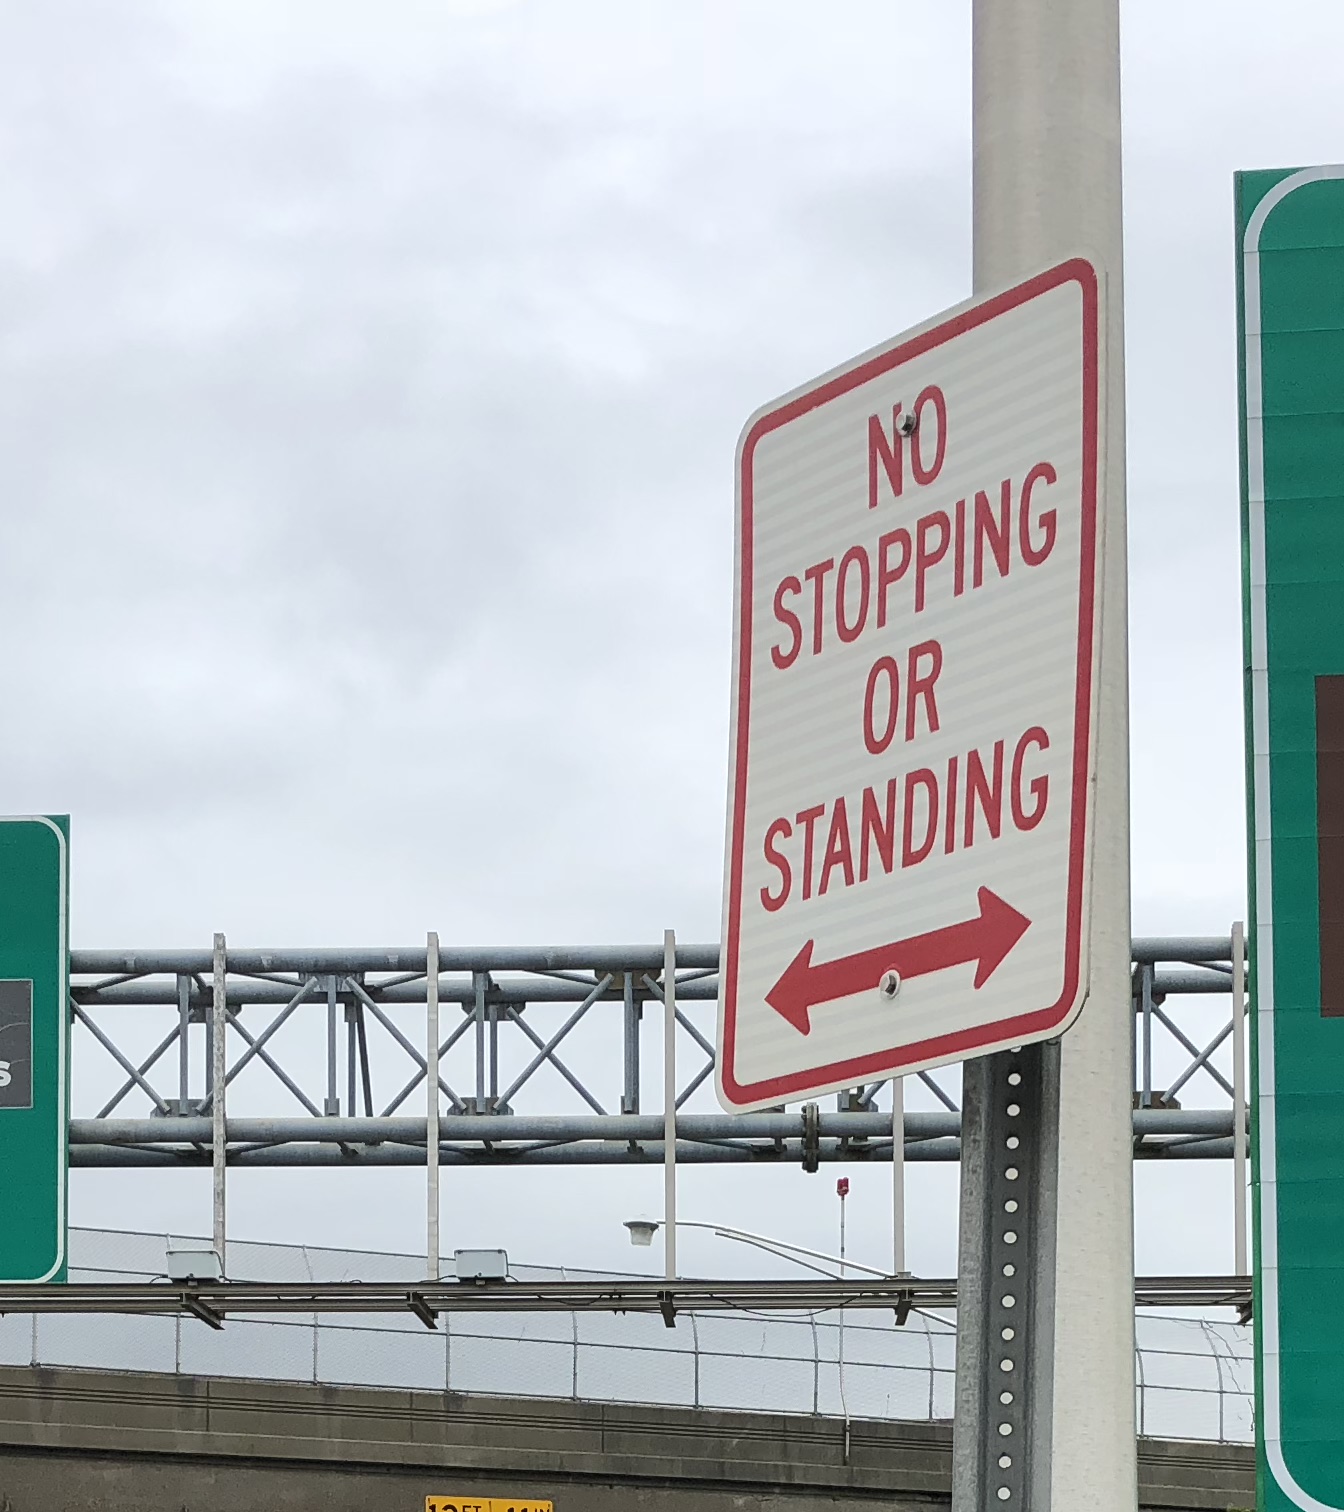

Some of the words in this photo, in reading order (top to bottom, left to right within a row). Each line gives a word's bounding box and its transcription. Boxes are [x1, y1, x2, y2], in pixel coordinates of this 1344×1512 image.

[868, 384, 947, 510] NO
[770, 461, 1057, 670] STOPPING
[863, 638, 943, 755] OR
[759, 725, 1050, 912] STANDING
